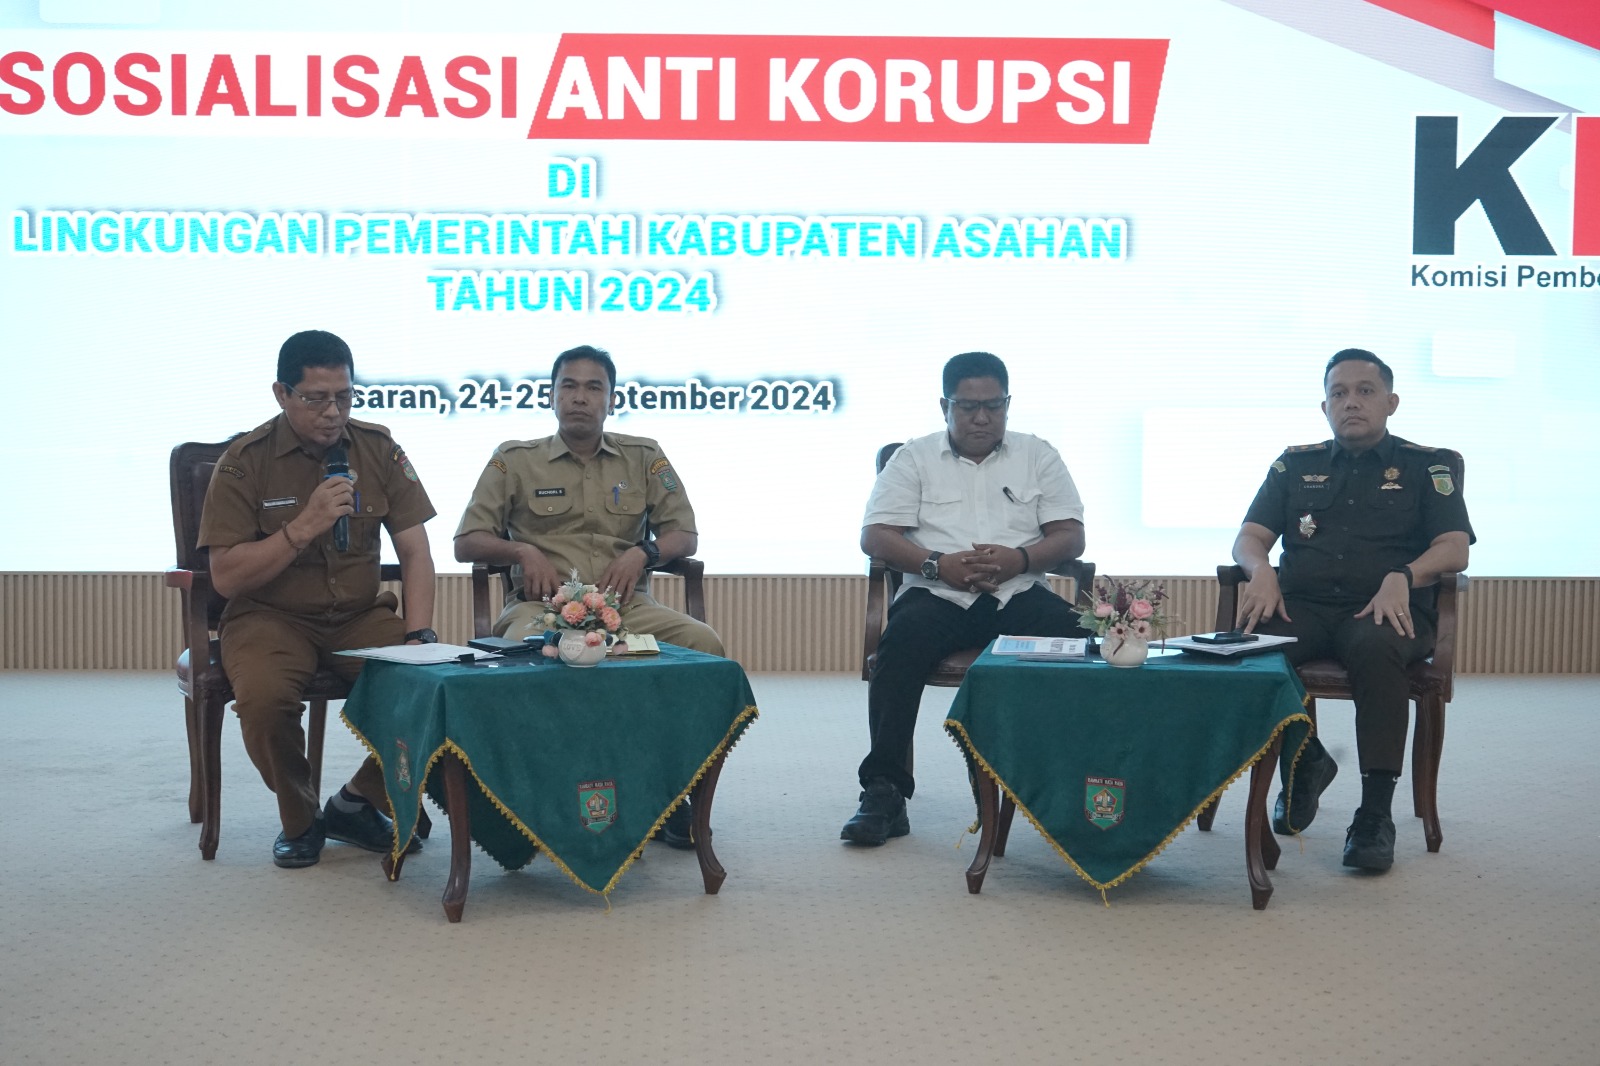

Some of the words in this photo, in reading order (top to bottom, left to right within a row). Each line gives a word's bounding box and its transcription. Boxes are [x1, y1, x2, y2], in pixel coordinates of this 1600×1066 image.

[0, 51, 517, 119] SOSIALISASI
[546, 55, 736, 121] ANTI
[768, 57, 1131, 125] KORUPSI
[548, 163, 590, 199] DI
[14, 215, 317, 254] LINGKUNGAN
[335, 219, 630, 256] PEMERINTAH
[648, 220, 916, 258] KABUPATEN
[932, 222, 1121, 259] ASAHAN
[427, 275, 582, 312] TAHUN
[600, 276, 711, 312] 2024
[1411, 264, 1507, 287] Komisi
[351, 388, 446, 414] saran,
[458, 383, 551, 409] 24-25
[750, 384, 831, 411] 2024
